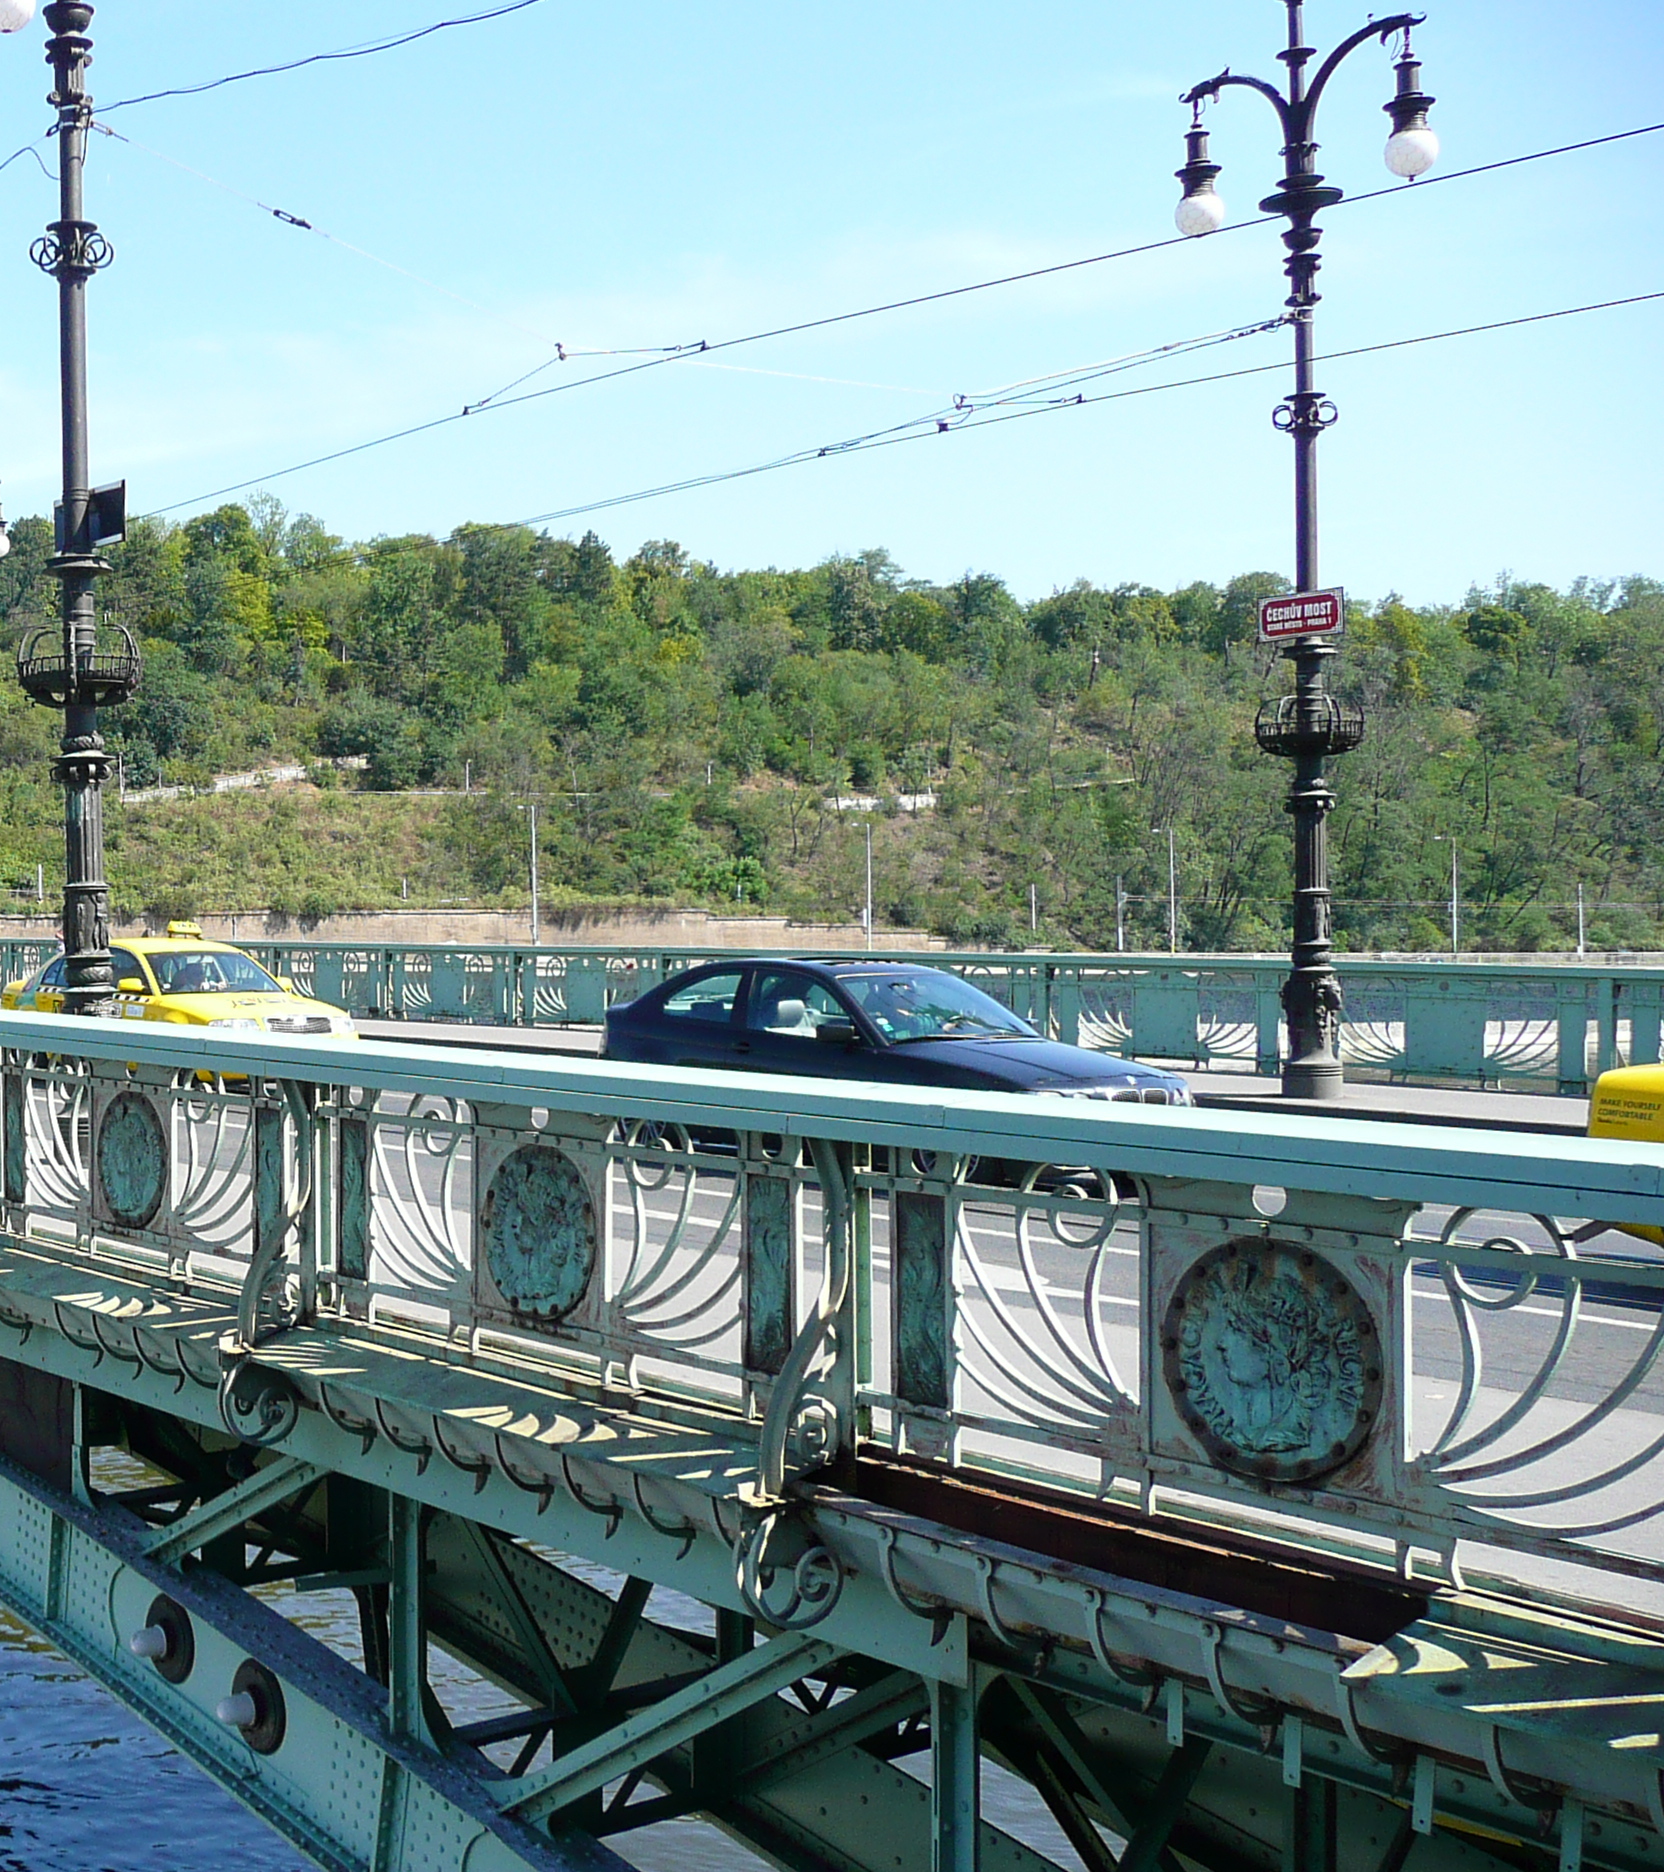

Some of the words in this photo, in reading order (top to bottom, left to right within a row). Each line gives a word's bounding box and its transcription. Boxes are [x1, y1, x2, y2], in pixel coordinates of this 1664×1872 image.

[1267, 603, 1302, 622] ČECHŮV
[1305, 601, 1332, 617] MOST
[1600, 1098, 1621, 1106] MAKE
[1623, 1100, 1662, 1111] YOURSELF
[1598, 1108, 1654, 1121] COMFORTABLE
